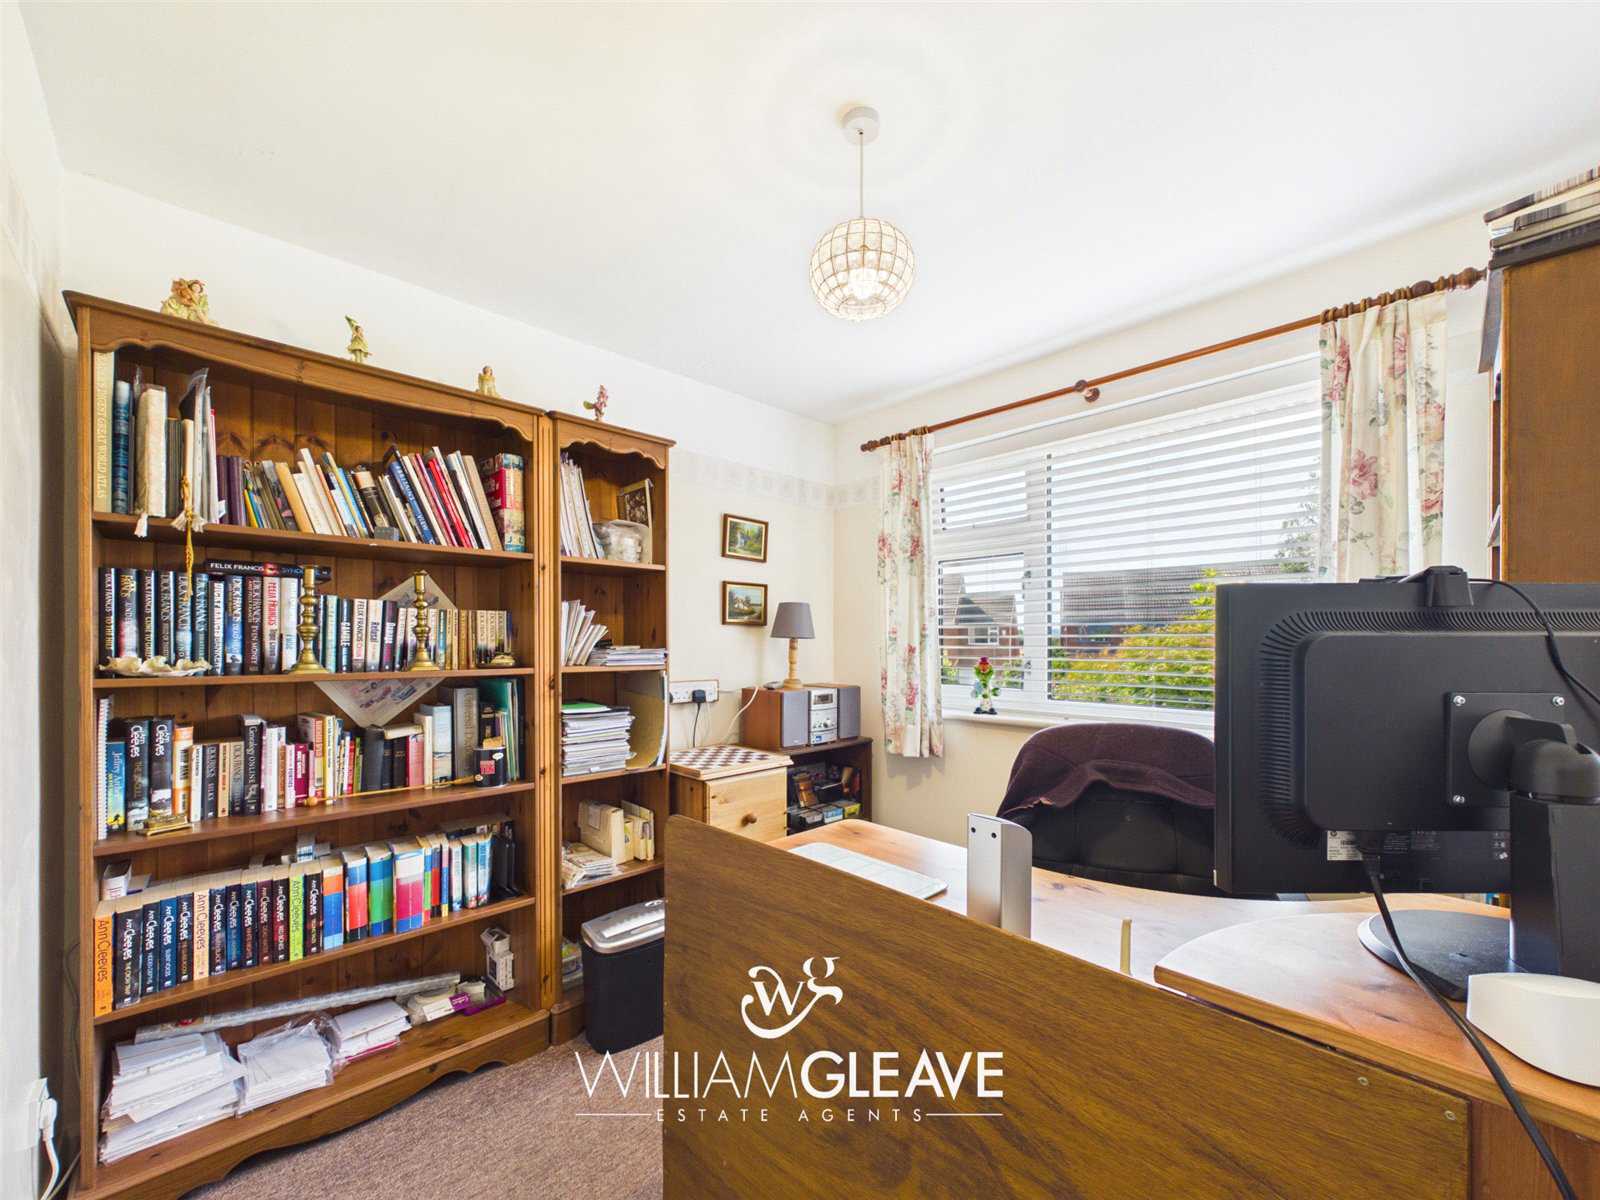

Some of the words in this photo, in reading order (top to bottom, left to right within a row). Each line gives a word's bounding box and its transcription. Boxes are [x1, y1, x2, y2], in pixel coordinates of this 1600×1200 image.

[233, 564, 264, 572] FRANCIS
[196, 577, 207, 597] DICK
[214, 583, 224, 603] DICK
[232, 579, 241, 596] DICK
[252, 580, 261, 598] DICK
[196, 599, 207, 631] FRANCIS
[214, 603, 224, 637] FRANCIS
[232, 597, 241, 622] FRANCIS
[252, 599, 261, 623] FRANCIS
[356, 601, 365, 617] FELIX
[356, 617, 364, 642] FRANCIS
[131, 725, 144, 757] Cleeves
[155, 724, 168, 757] Cleeves
[247, 725, 258, 755] Genealogy
[113, 751, 123, 773] Jeffrey
[291, 879, 301, 897] Ann
[197, 894, 206, 912] Ann
[229, 900, 240, 928] Cleeves
[244, 899, 255, 927] Cleeves
[260, 896, 270, 923] Cleeves
[276, 895, 286, 922] Cleeves
[291, 898, 302, 933] Cleeves
[310, 889, 319, 915] Cleeves
[98, 920, 109, 941] Ann
[163, 915, 175, 945] Cleeves
[180, 911, 191, 940] Cleeves
[196, 912, 208, 950] Cleeves
[214, 904, 224, 932] Cleeves
[123, 928, 136, 960] Cleeves
[146, 920, 158, 950] Cleeves
[97, 941, 110, 983] Cleeves
